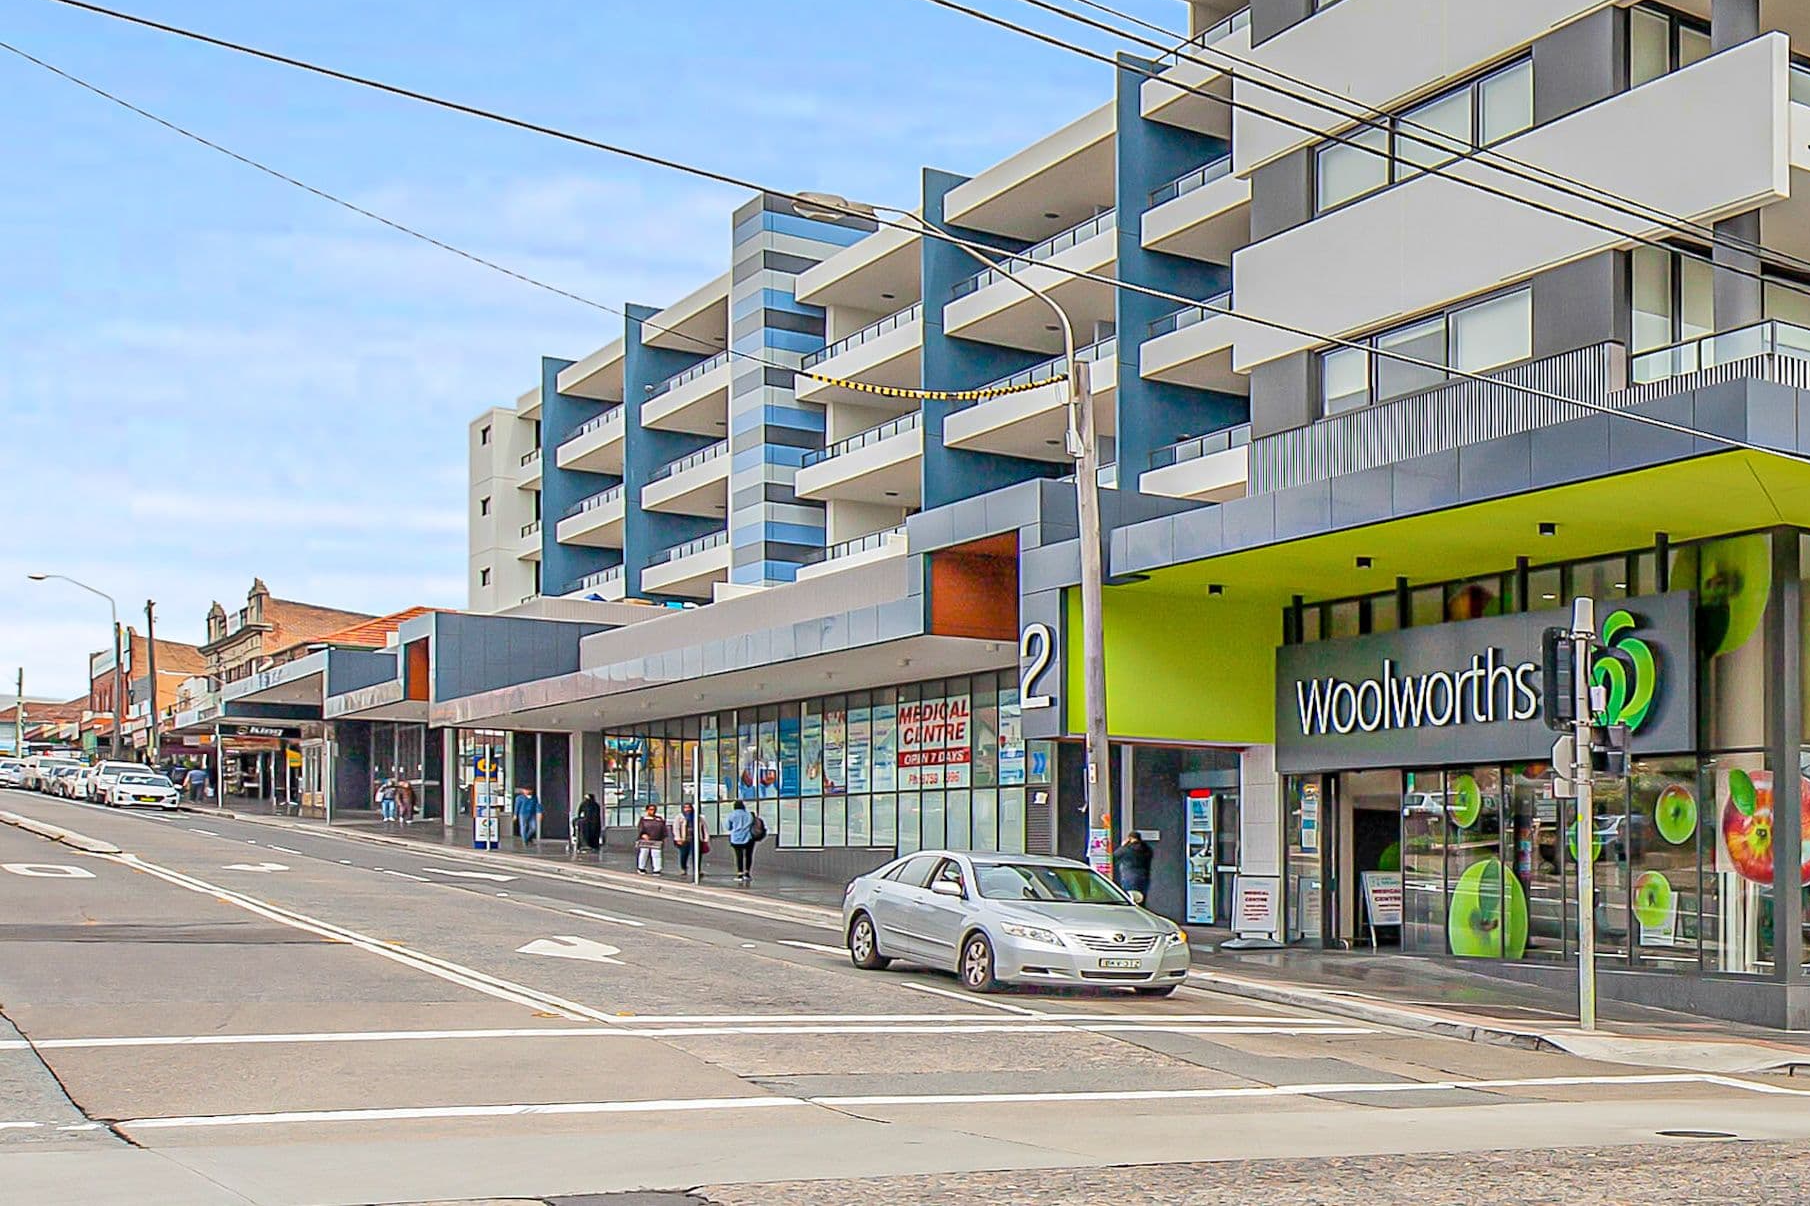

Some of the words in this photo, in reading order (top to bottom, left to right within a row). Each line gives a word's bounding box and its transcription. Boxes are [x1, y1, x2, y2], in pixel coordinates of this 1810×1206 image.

[1020, 622, 1051, 708] 2
[1296, 646, 1537, 735] Woolworths
[899, 699, 969, 725] MEDICAL
[903, 722, 966, 745] CENTRE
[931, 753, 938, 763] 7
